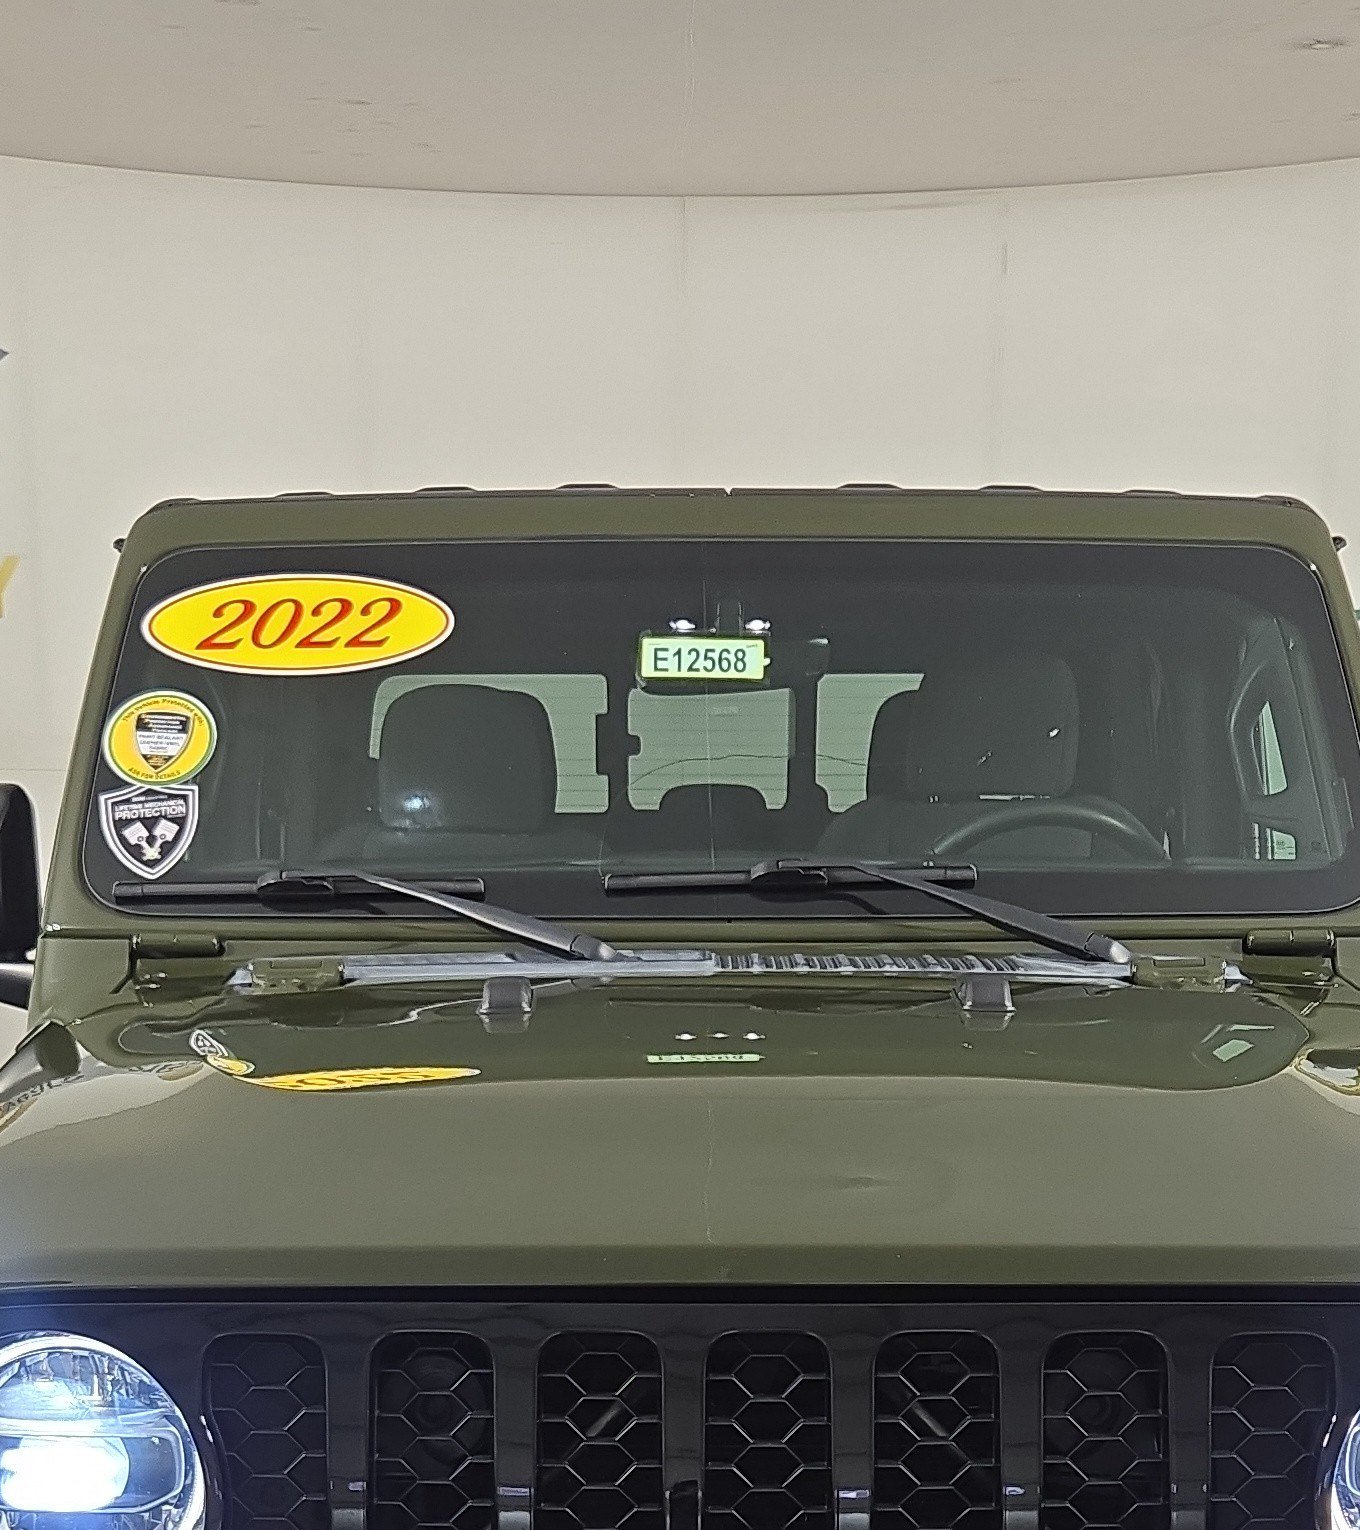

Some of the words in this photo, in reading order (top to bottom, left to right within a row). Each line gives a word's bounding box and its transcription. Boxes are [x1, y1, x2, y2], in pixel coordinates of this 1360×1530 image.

[194, 597, 403, 651] 2022
[653, 647, 747, 673] E12568
[114, 805, 187, 821] PROTECTION
